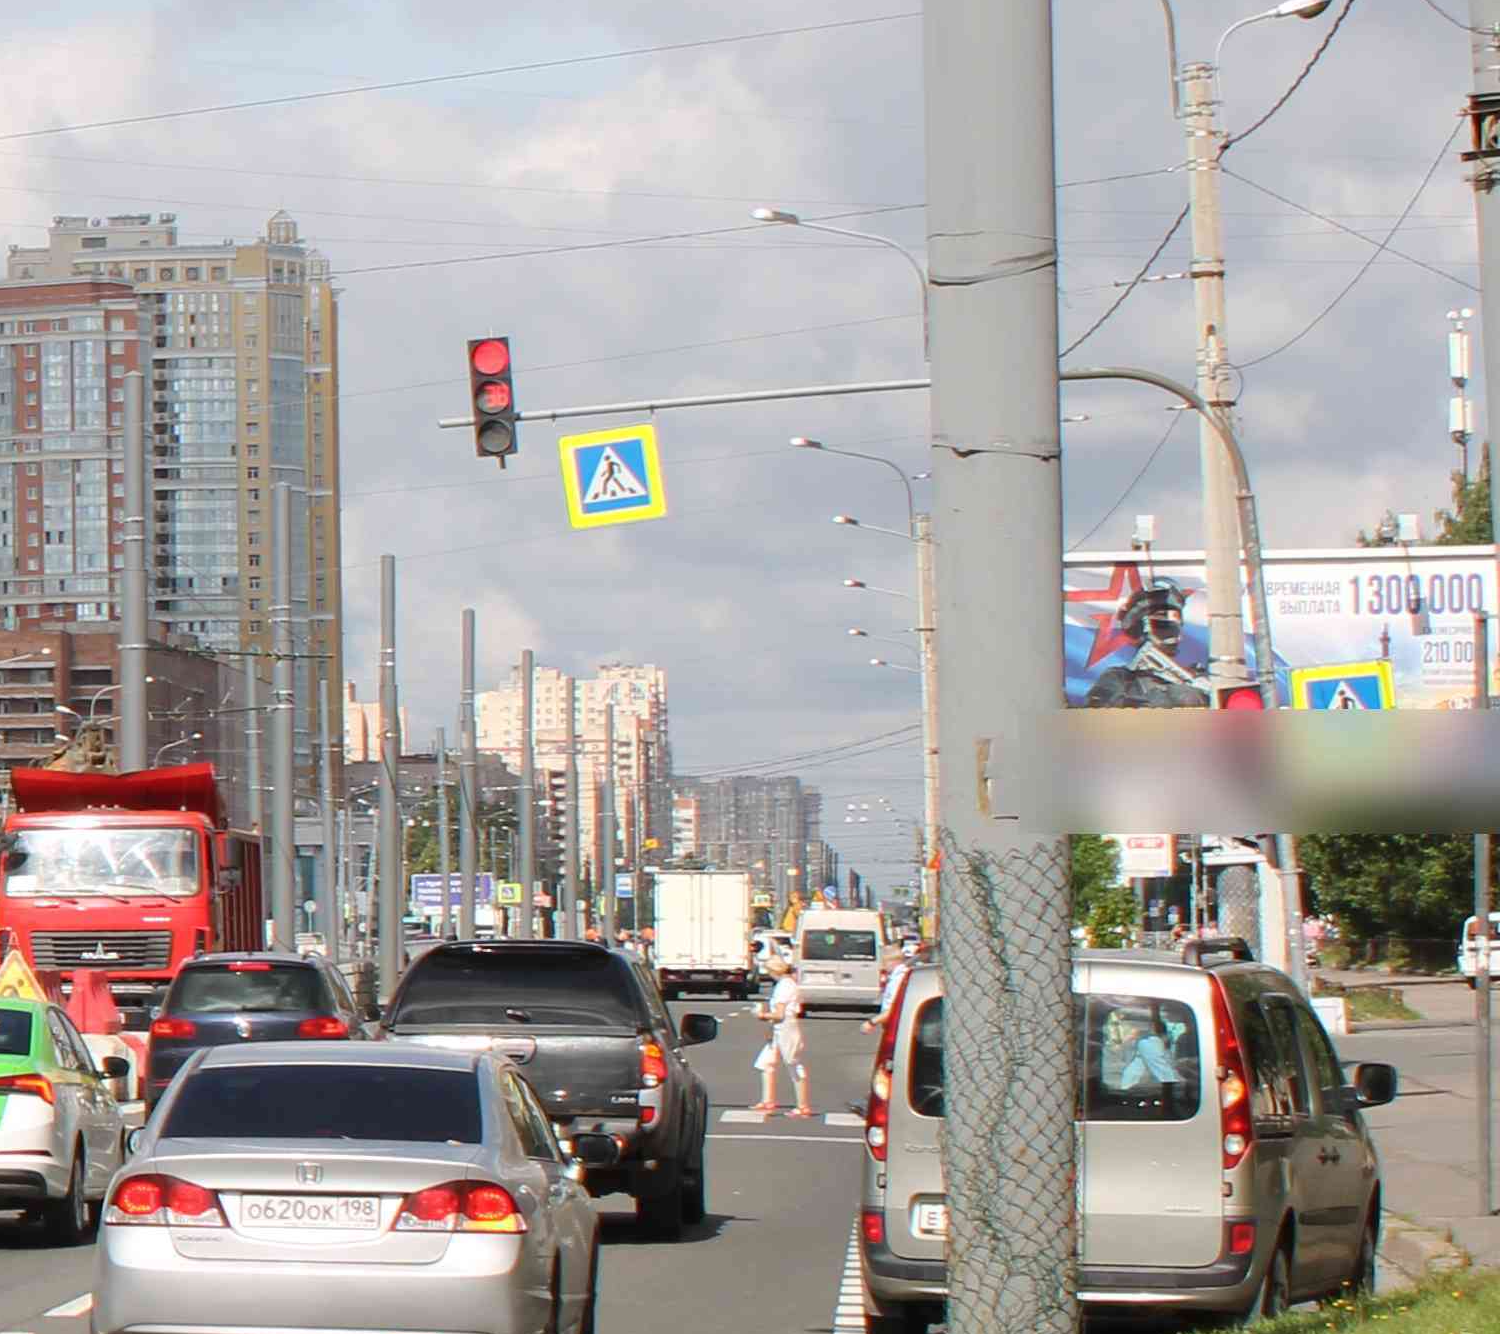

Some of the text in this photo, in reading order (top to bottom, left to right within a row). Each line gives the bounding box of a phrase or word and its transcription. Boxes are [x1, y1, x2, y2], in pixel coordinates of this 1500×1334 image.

[1266, 581, 1341, 596] ВРЕМЕННАЯ
[1280, 599, 1341, 615] ВЫПЛАТА
[339, 1199, 374, 1216] 198
